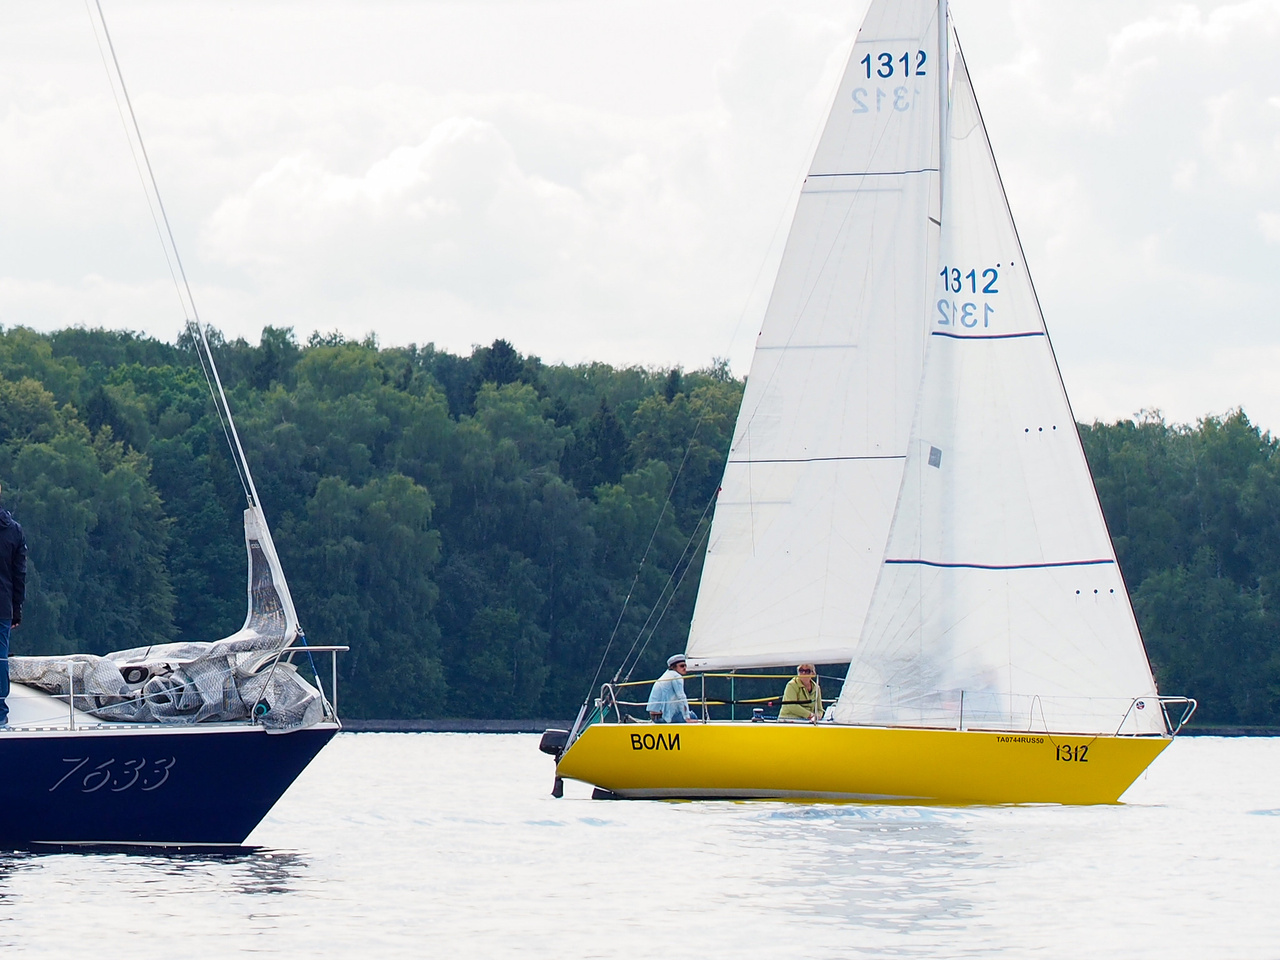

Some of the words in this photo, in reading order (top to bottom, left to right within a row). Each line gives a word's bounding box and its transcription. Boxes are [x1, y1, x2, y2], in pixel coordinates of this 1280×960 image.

[860, 49, 927, 79] 1312
[939, 265, 999, 294] 1312
[1056, 744, 1089, 762] 1312
[49, 756, 176, 793] 7633
